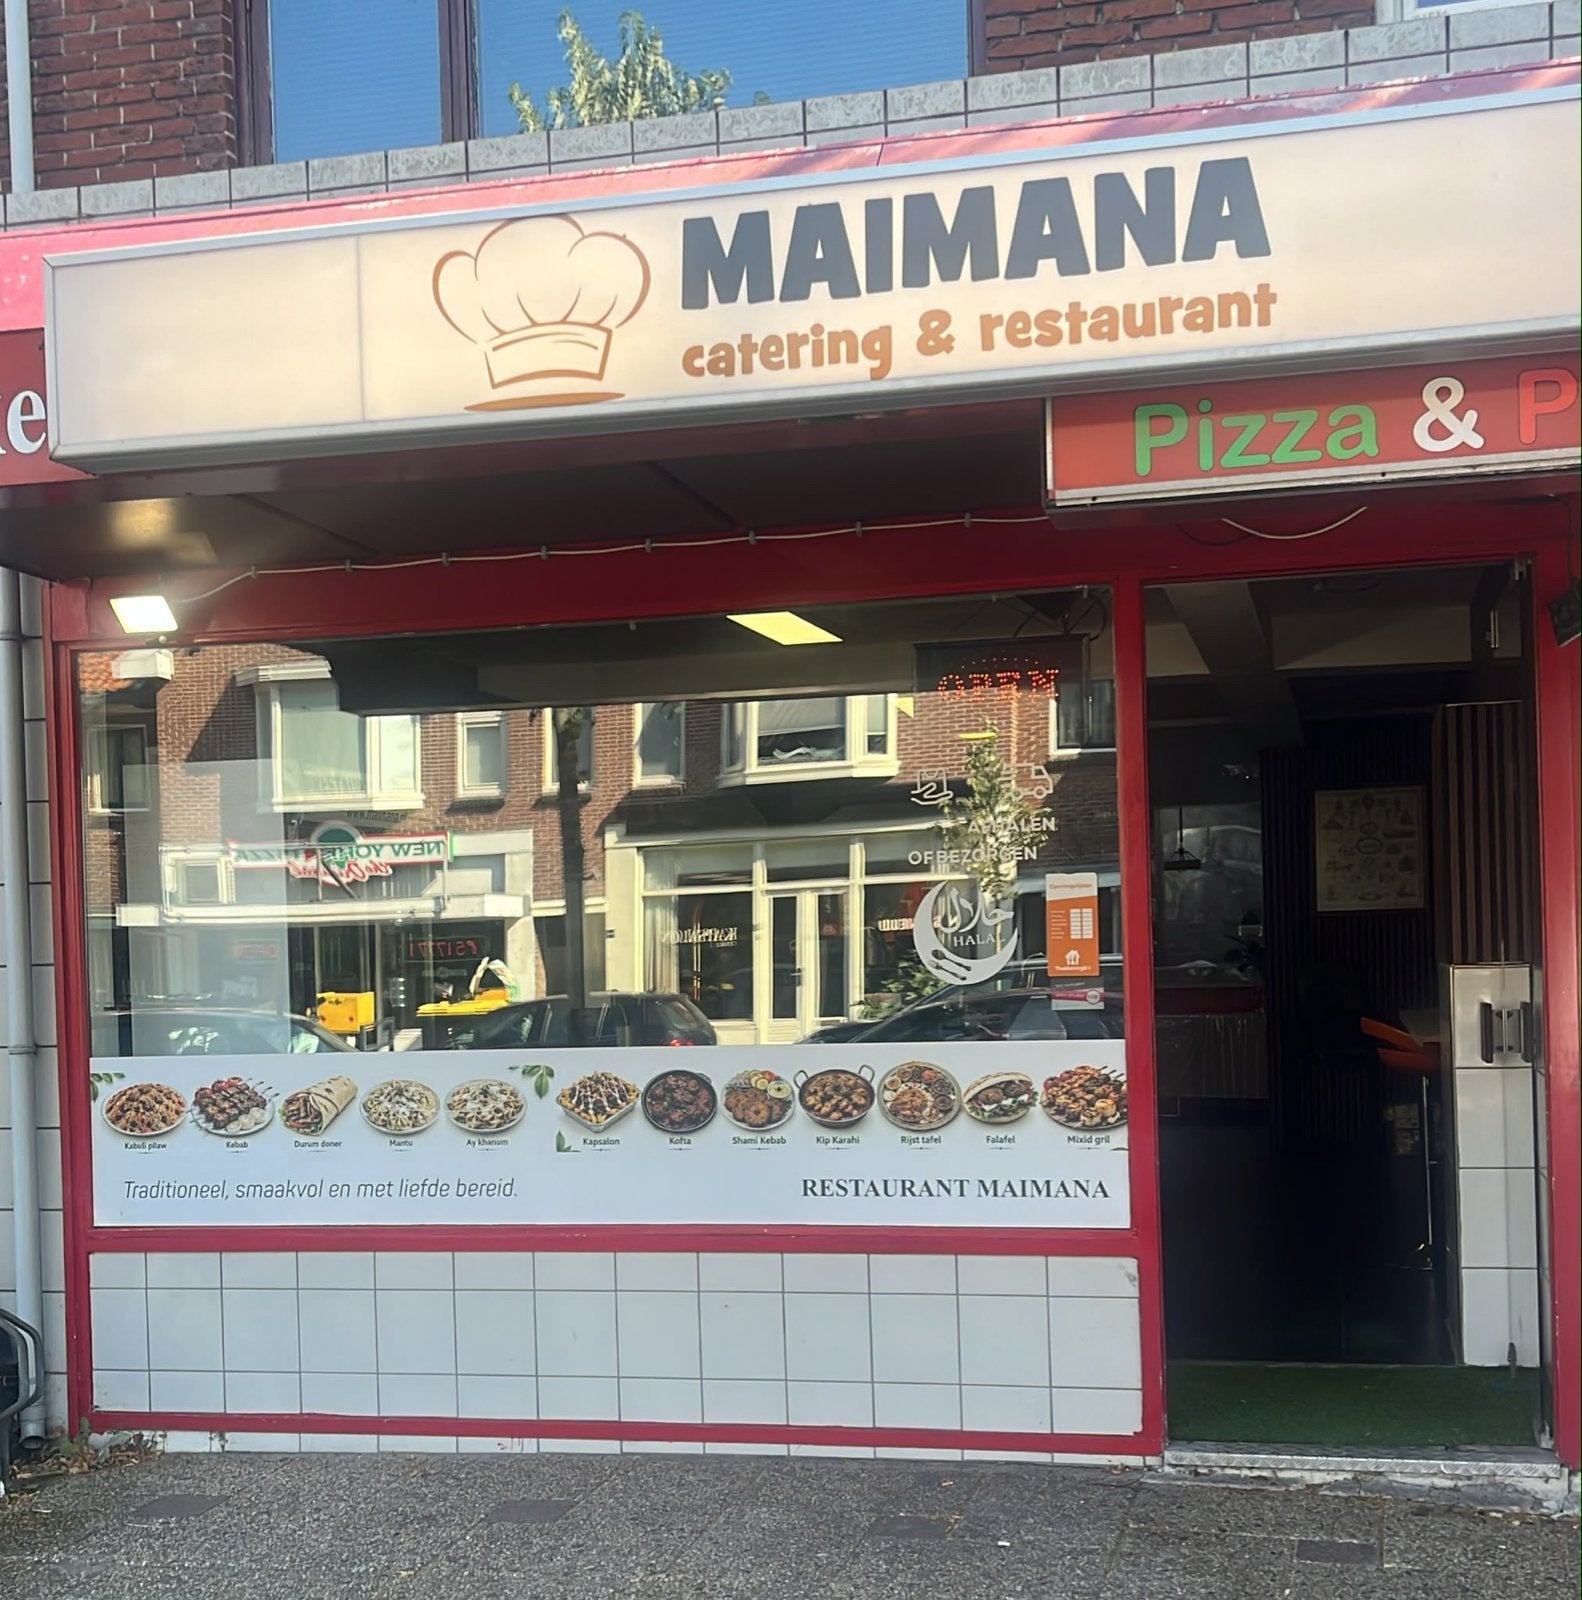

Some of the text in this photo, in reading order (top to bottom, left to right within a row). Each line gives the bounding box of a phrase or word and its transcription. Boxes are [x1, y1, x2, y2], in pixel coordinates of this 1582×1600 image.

[682, 157, 1272, 310] MAIMANA
[682, 283, 1277, 381] catering & restaurant
[0, 390, 47, 455] e
[1134, 399, 1380, 477] Pizza
[1412, 376, 1485, 452] &
[938, 669, 1059, 701] OPEN
[967, 817, 1056, 834] AFHALEN
[294, 1140, 342, 1148] Durum doner
[389, 1139, 413, 1147] Mantu
[466, 1138, 508, 1148] Ay khanum
[583, 1137, 620, 1147] Kapsalon
[669, 1137, 692, 1145] Kofta
[732, 1136, 787, 1145] Shami Kebab
[816, 1136, 860, 1146] Kip Karahi
[901, 1136, 942, 1146] Rijst tafel
[986, 1135, 1016, 1144] Falafel
[1067, 1135, 1110, 1147] Mixid gril
[124, 1142, 167, 1152] Kabuli pilaw
[226, 1141, 248, 1149] Kebab
[124, 1178, 518, 1200] Traditioneel, smaakvol en met liefde bereid.
[802, 1179, 1111, 1198] RESTAURANT MAIMANA
